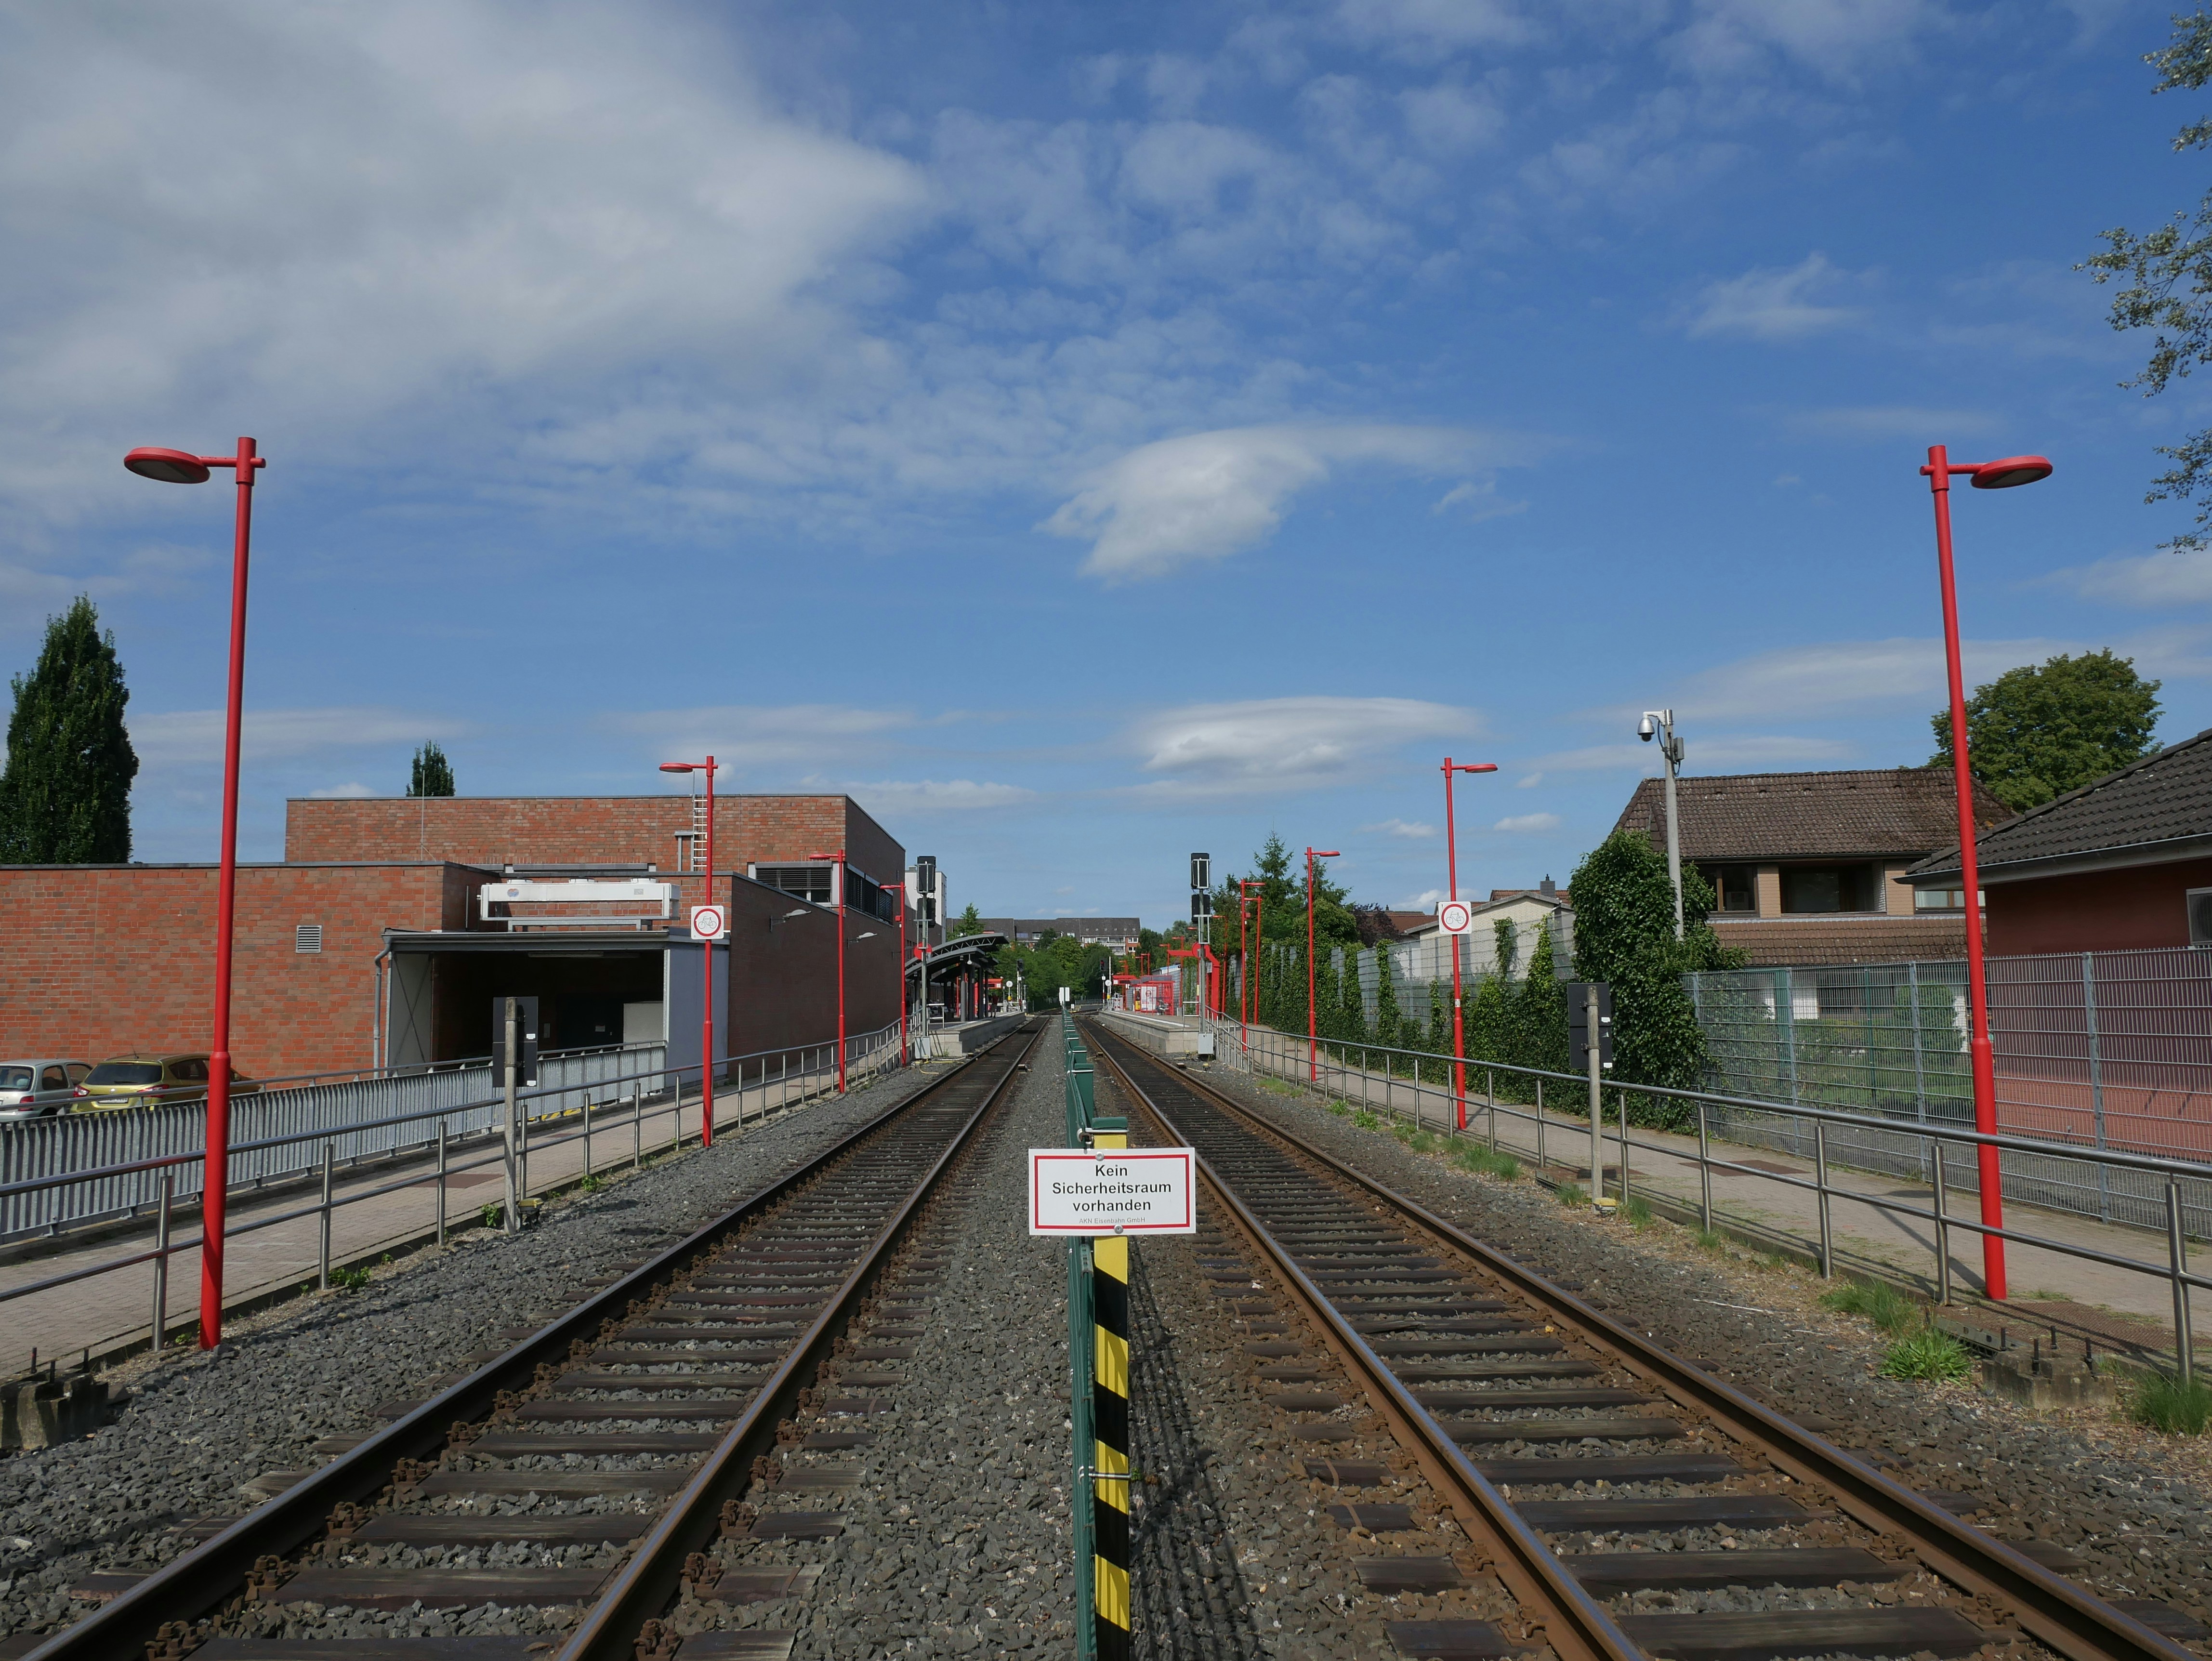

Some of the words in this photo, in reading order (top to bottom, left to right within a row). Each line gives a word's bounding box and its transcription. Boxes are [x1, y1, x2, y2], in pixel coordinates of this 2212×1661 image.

[1095, 1164, 1128, 1176] Kein
[1052, 1182, 1172, 1194] Sicherheitsraum
[1073, 1199, 1151, 1212] vorhanden
